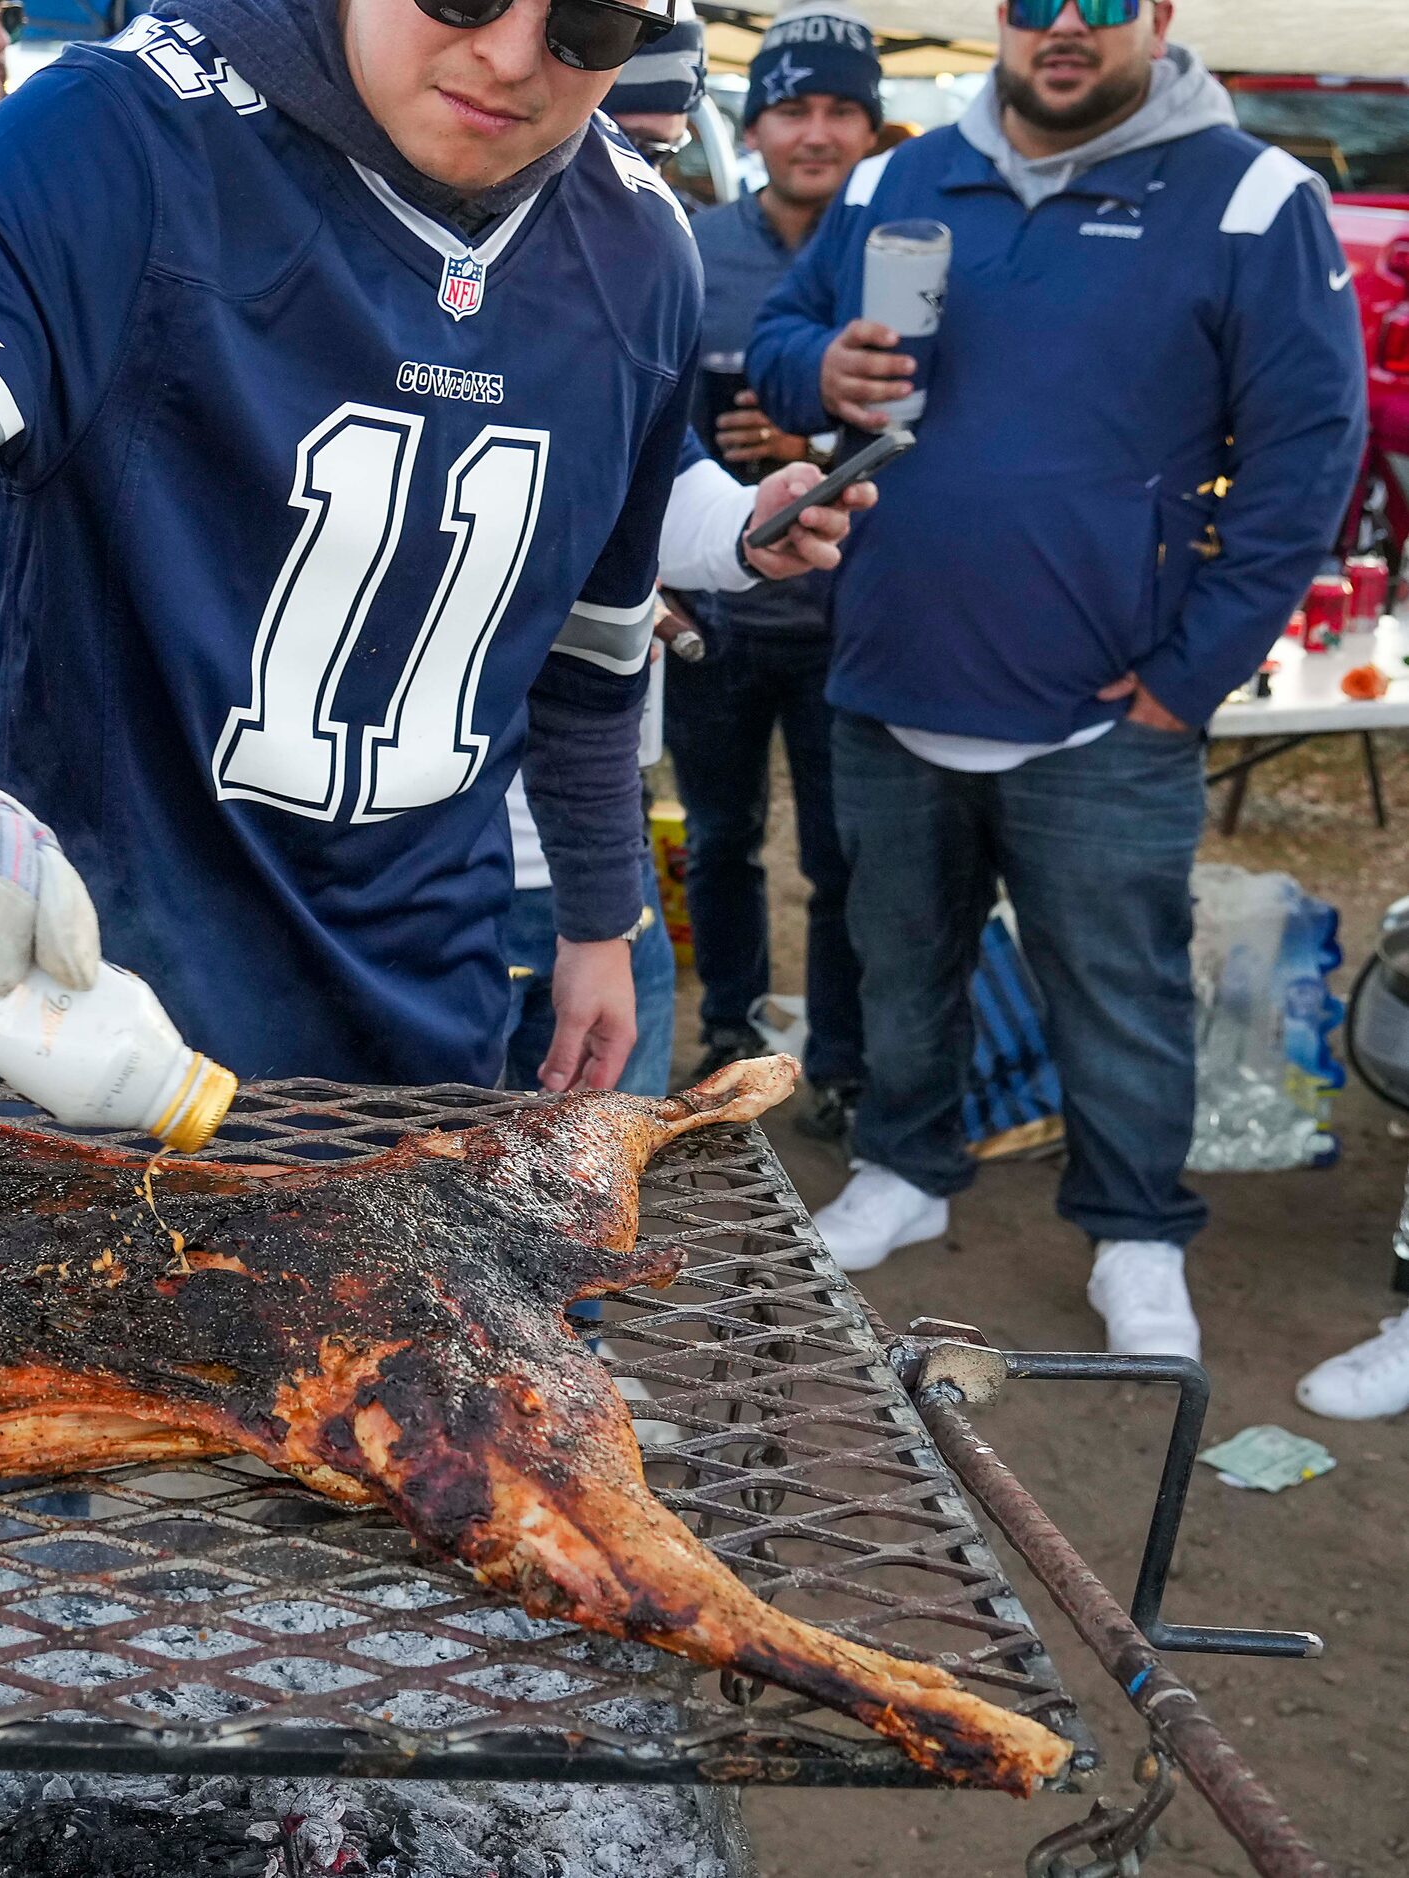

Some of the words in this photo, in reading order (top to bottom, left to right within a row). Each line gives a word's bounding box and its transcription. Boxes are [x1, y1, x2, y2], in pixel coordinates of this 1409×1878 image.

[446, 278, 477, 308] NFL
[396, 360, 504, 404] COWBOYS
[211, 401, 551, 824] 11
